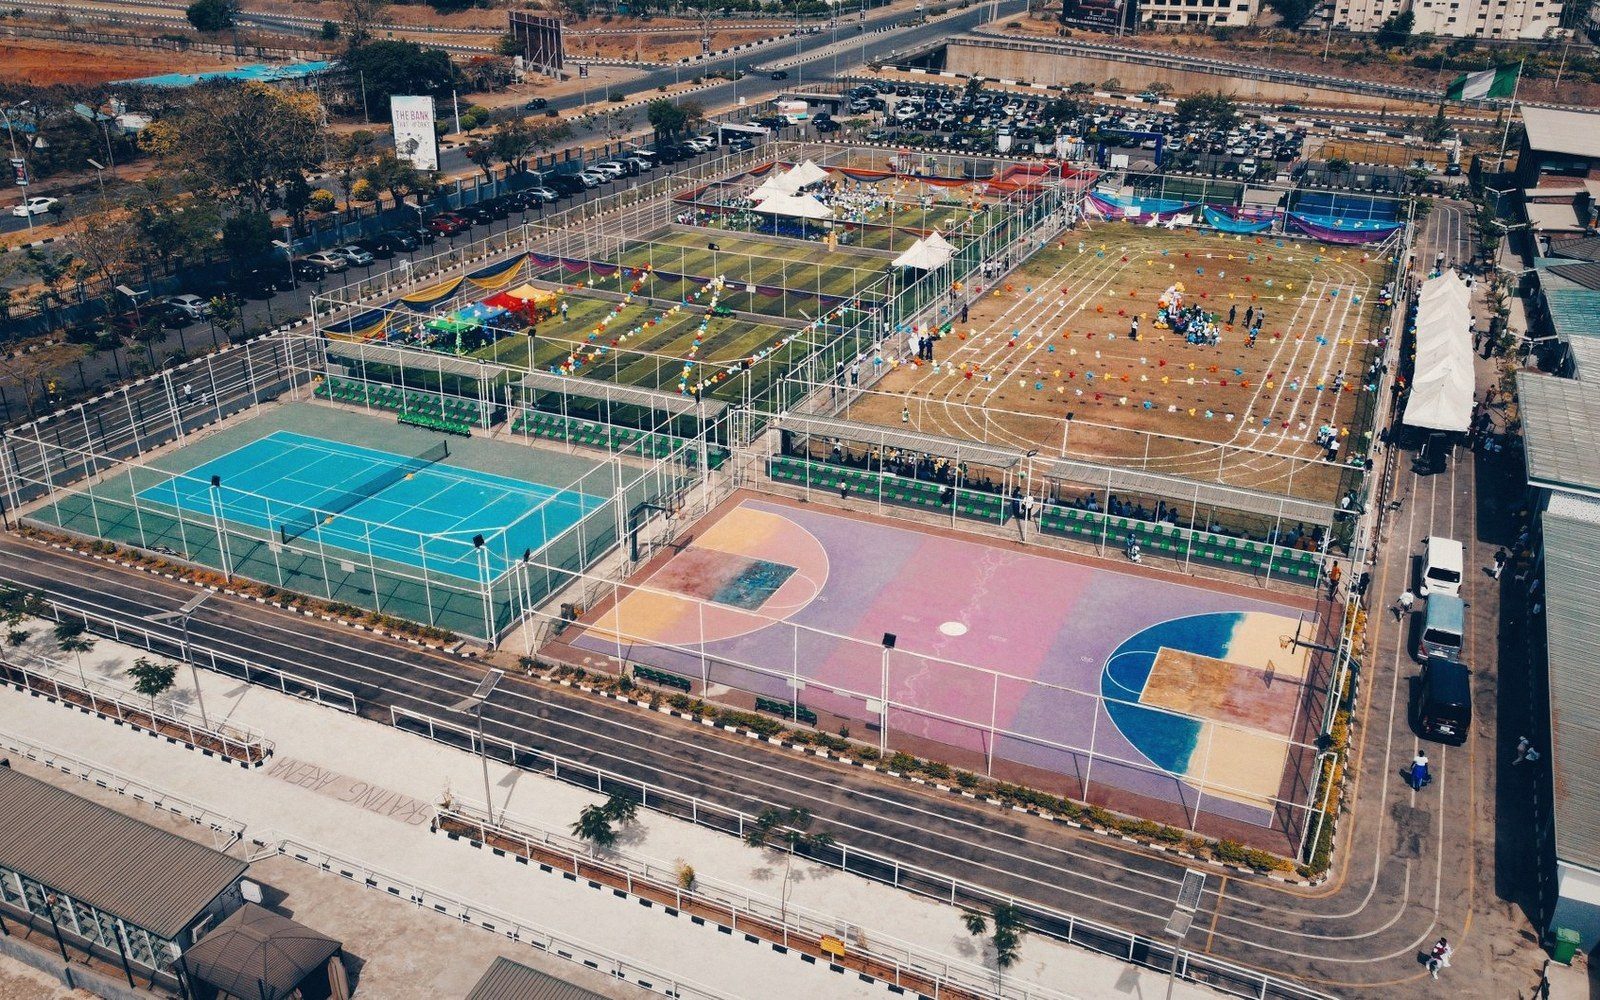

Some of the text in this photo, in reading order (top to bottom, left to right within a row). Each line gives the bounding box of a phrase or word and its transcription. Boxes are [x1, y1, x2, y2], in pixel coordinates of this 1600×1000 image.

[395, 110, 430, 121] THE BANK
[266, 756, 435, 826] SKATING ARENA
